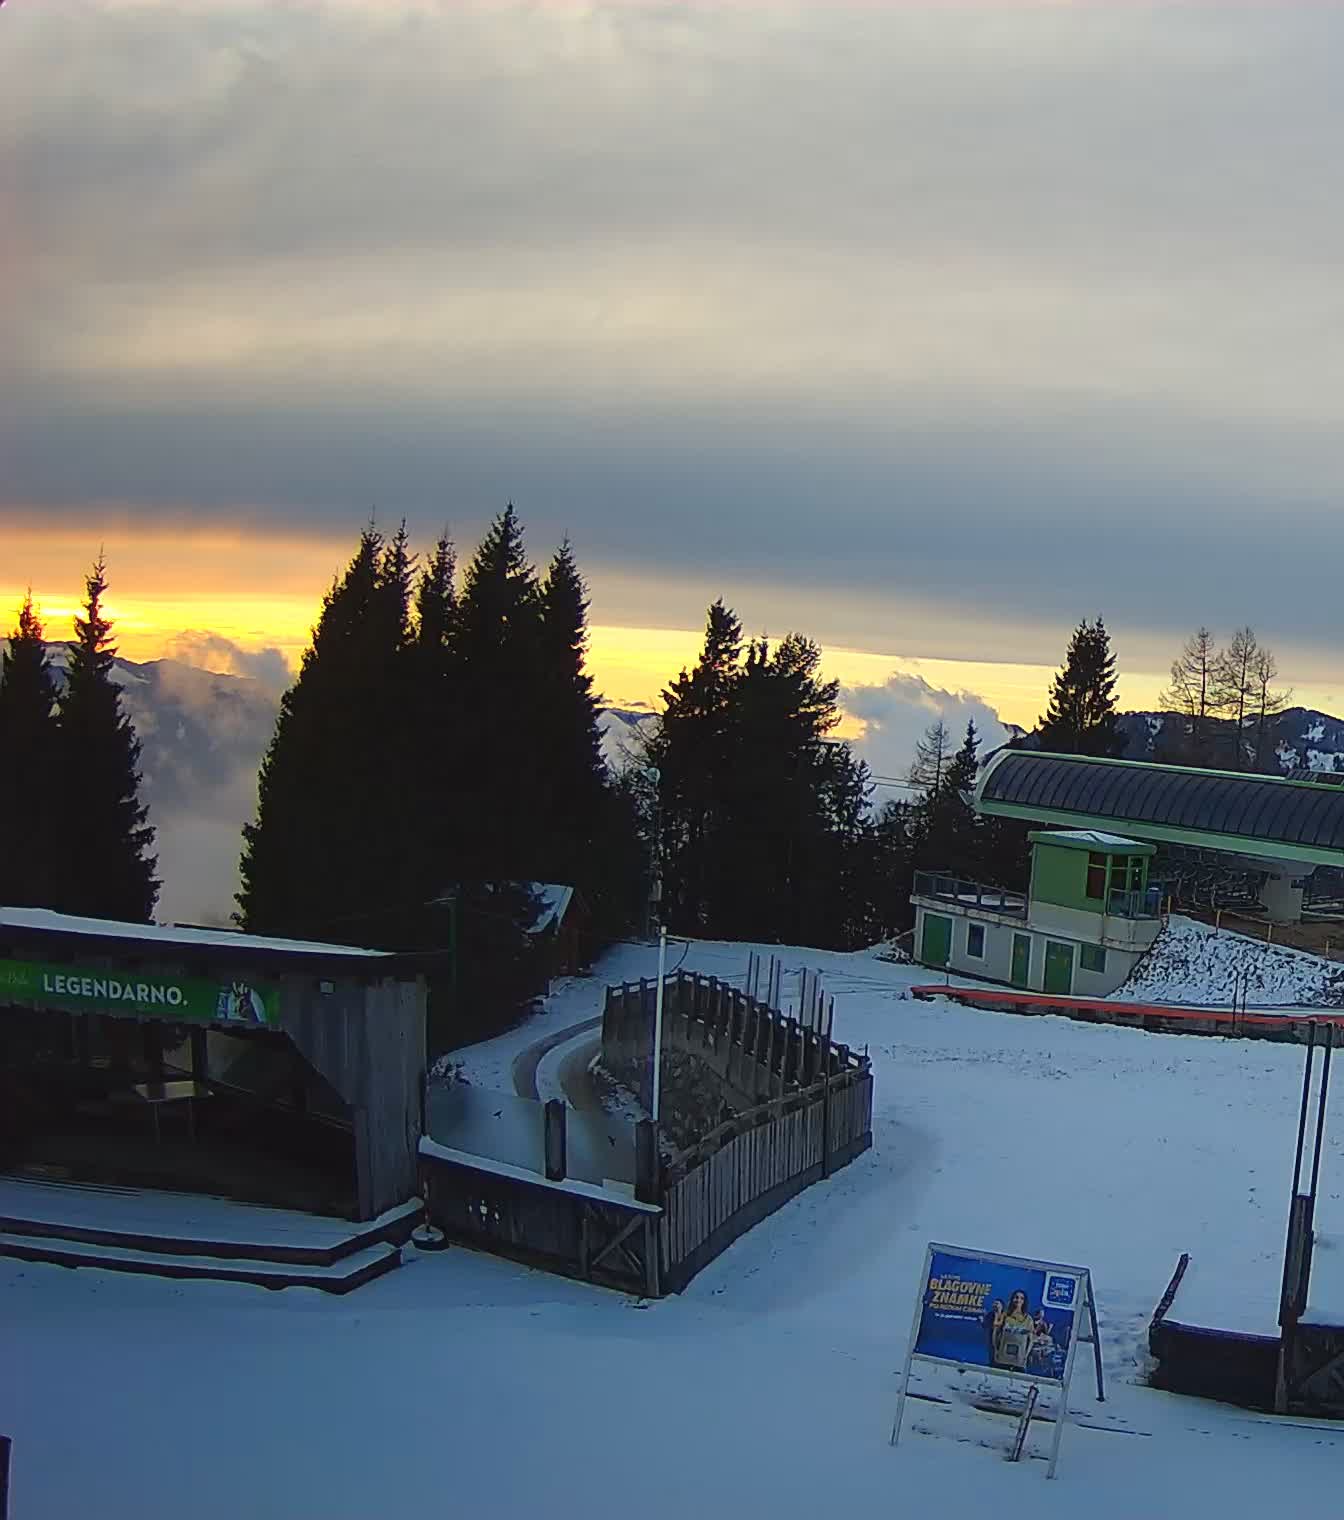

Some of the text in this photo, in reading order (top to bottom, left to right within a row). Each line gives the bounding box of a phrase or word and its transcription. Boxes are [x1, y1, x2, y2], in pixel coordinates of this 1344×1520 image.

[43, 973, 189, 1007] LEGENDARNO.
[929, 1278, 993, 1296] BLAGOVNE
[932, 1291, 985, 1306] ZNAMKE
